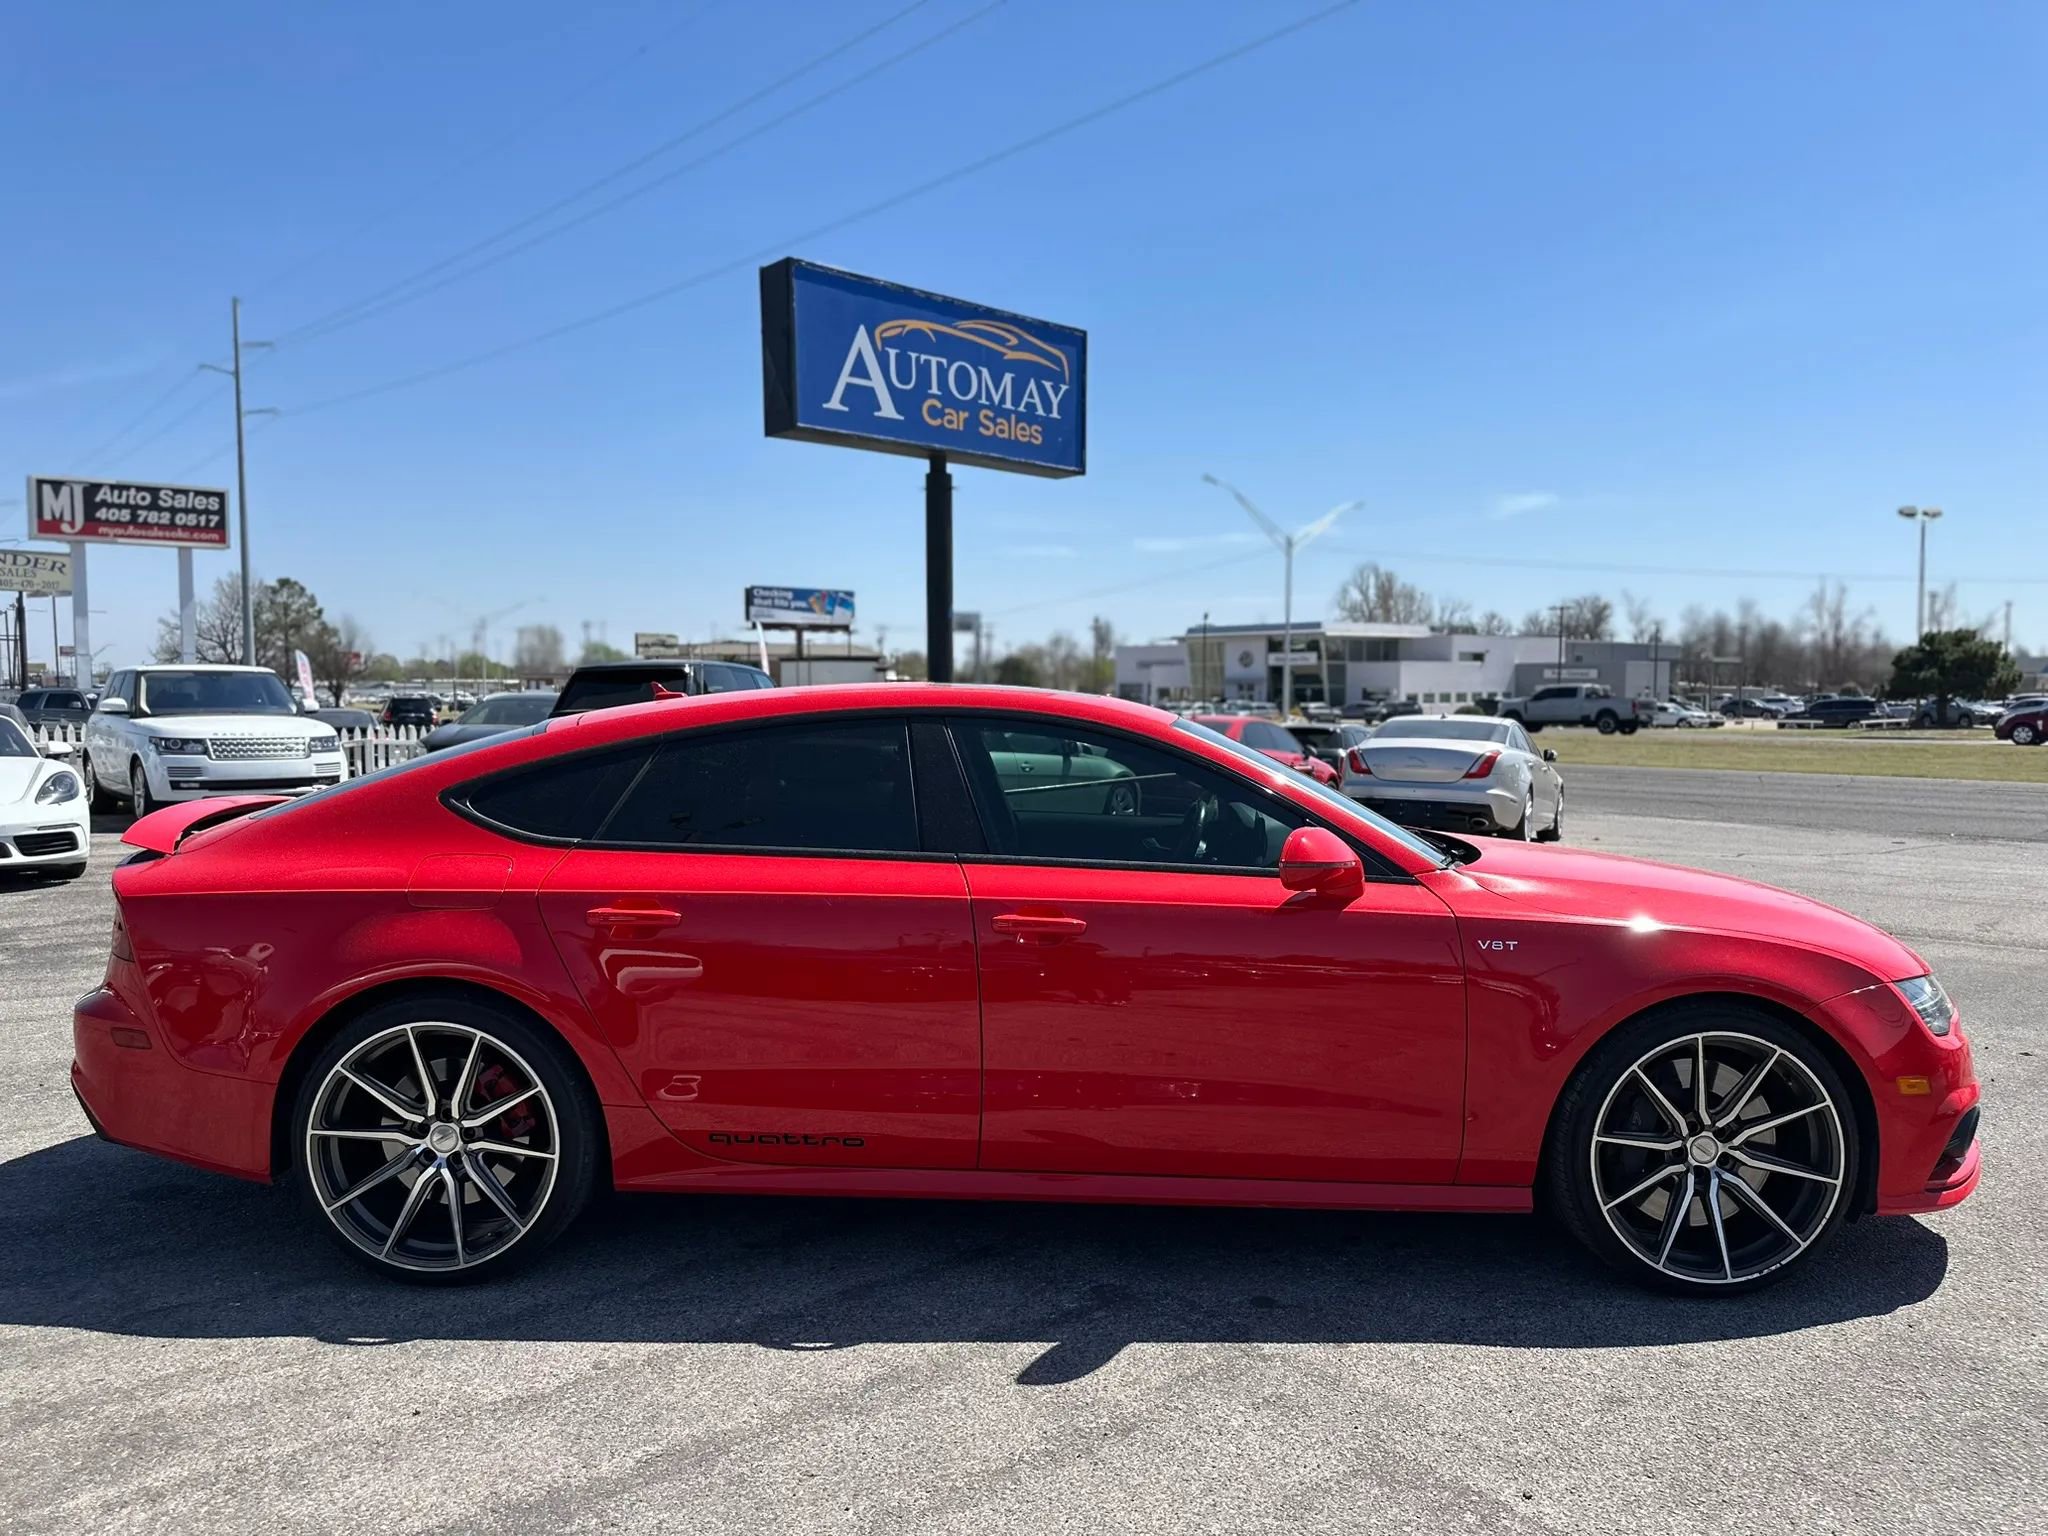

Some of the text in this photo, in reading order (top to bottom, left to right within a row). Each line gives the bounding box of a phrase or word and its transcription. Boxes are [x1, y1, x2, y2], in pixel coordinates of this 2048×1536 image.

[822, 323, 1069, 420] AUTOMAY
[921, 398, 1043, 445] Car Sales
[42, 482, 90, 534] MJ
[95, 485, 220, 511] Auto Sales
[95, 507, 219, 528] 405 782 0517
[0, 567, 37, 578] SALES
[1477, 939, 1519, 951] V8T
[708, 1132, 866, 1147] quattro
